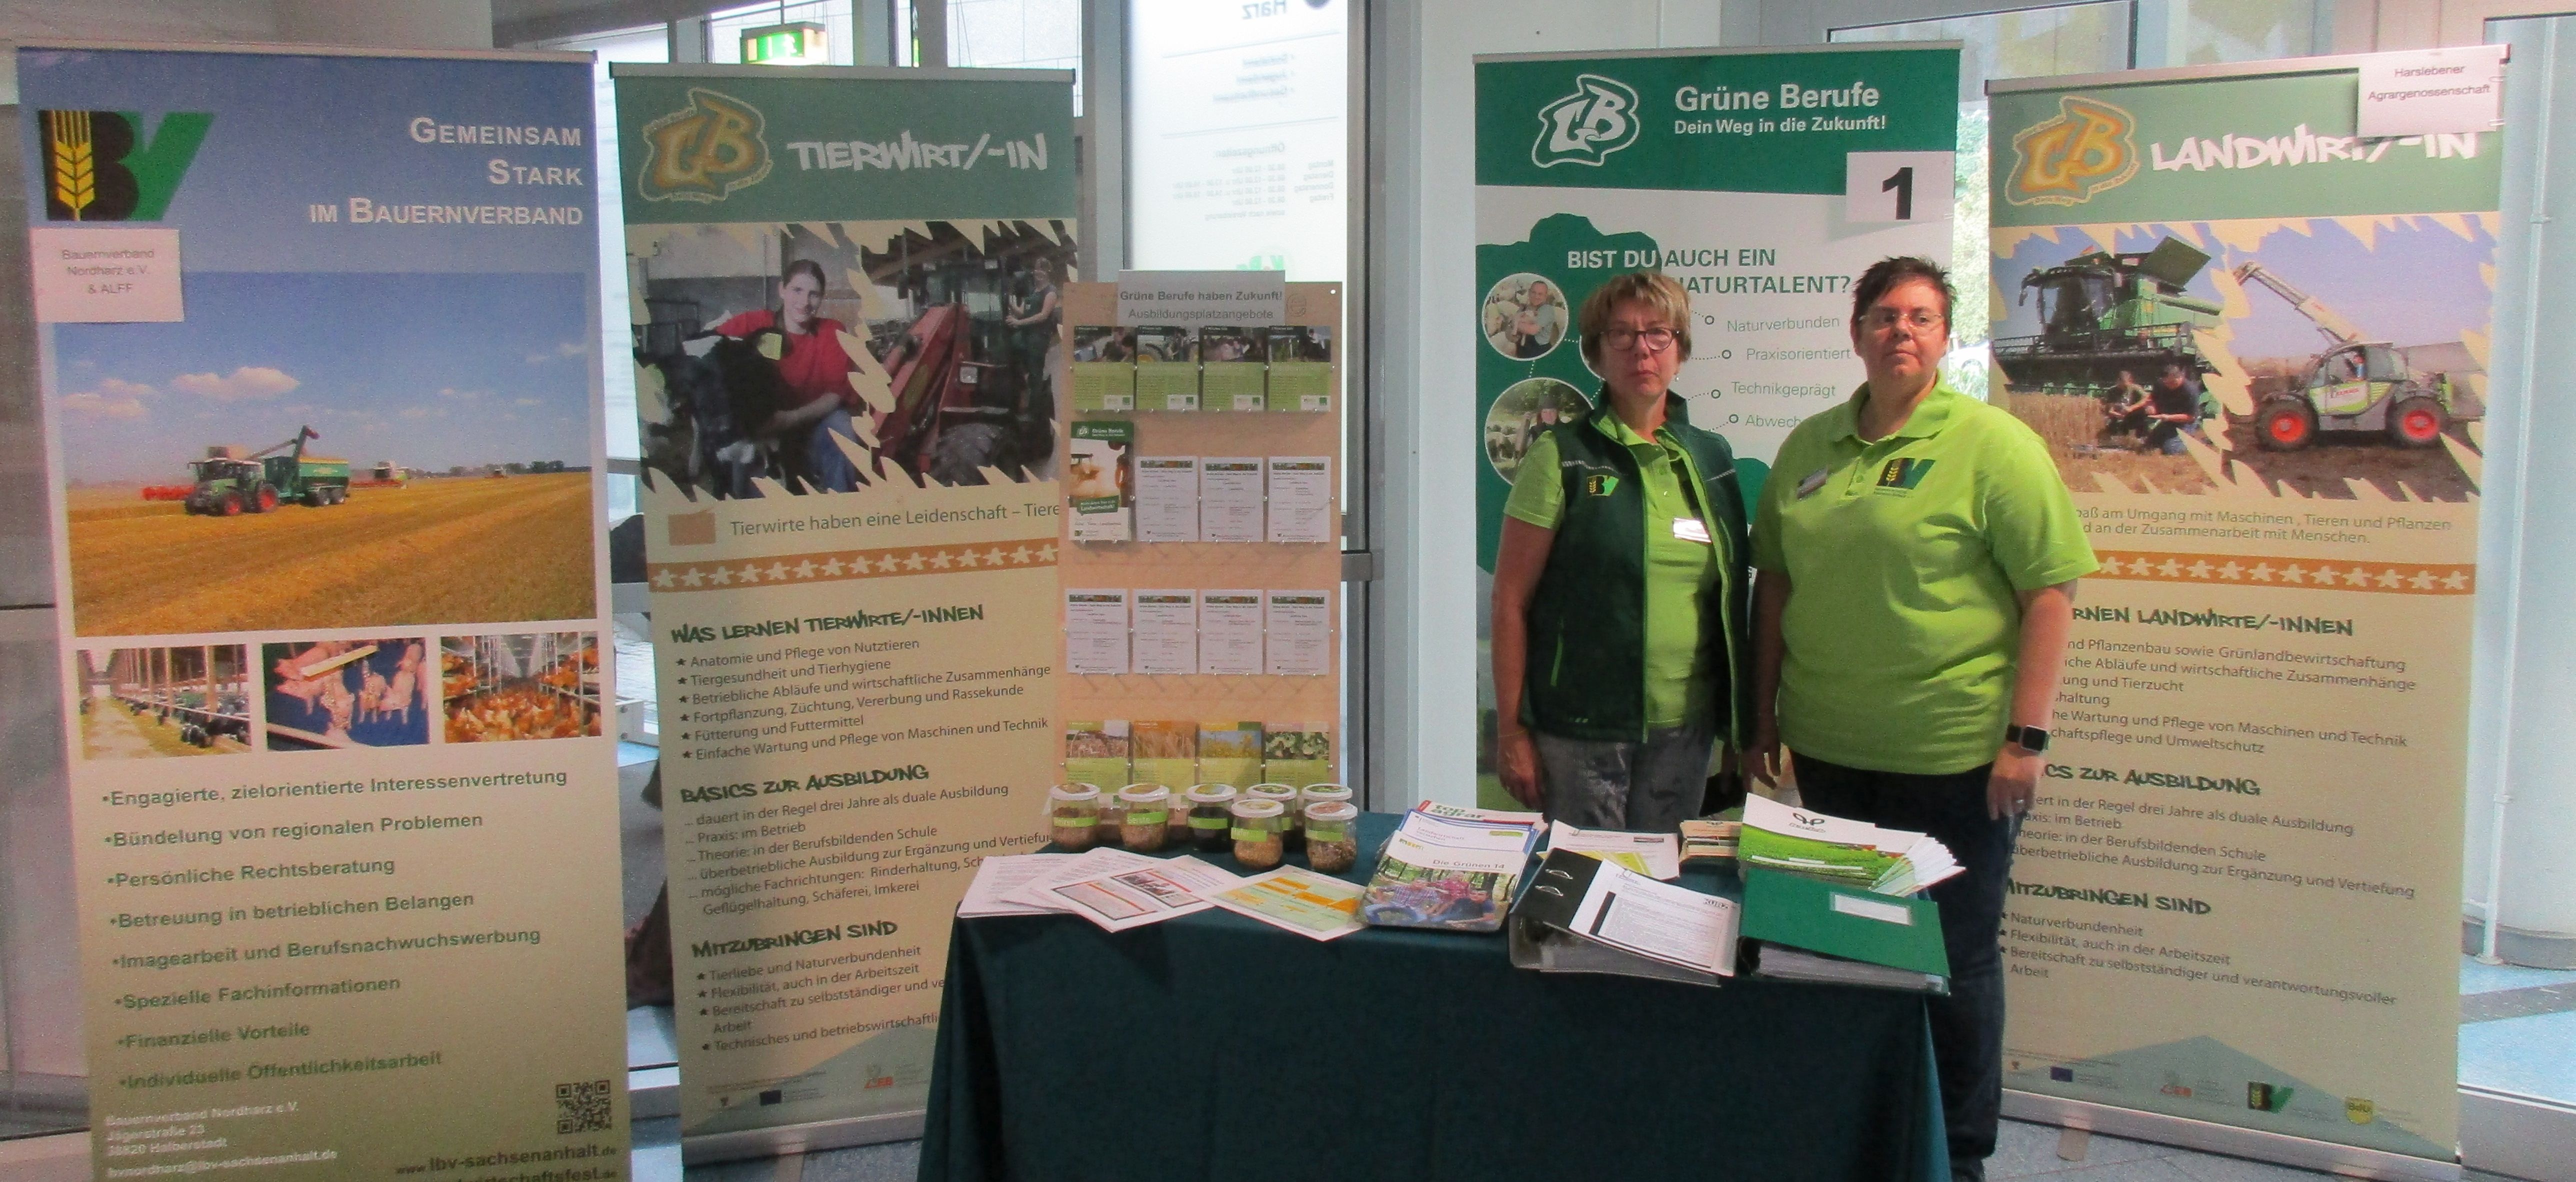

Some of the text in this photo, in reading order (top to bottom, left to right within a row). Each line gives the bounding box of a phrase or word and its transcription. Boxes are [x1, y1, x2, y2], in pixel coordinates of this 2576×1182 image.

[2394, 64, 2465, 78] Harslebener
[1675, 81, 1879, 112] Grüne Berufe
[2368, 84, 2490, 102] Agrargenossenschaft
[410, 116, 581, 147] GEMEINSAM
[1674, 115, 1886, 136] Dein Weg in die Zukunft!
[488, 160, 582, 186] STARK
[1882, 166, 1912, 219] 1
[310, 198, 582, 226] IM BAUERNVERBAND
[62, 250, 154, 260] Bauernverband
[1568, 248, 1776, 268] BIST DU AUCH EIN
[66, 266, 124, 275] Nordharz
[102, 283, 133, 294] ALFF
[1120, 290, 1282, 300] Grüne Berufe haben Zukunft!
[1128, 308, 1274, 322] Ausbildungsplatzangebote
[1727, 316, 1840, 332] Naturverbunden
[1747, 348, 1850, 360] Praxisorientiert
[1732, 382, 1836, 398] Technikgeprägt
[730, 502, 1060, 536] Tierwirte haben eine Leidenschaft Tiere
[2102, 510, 2124, 519] am
[2127, 508, 2186, 524] Umgang
[2190, 512, 2213, 522] mit
[2217, 510, 2294, 524] Maschinen
[2304, 513, 2349, 527] Tieren
[2353, 516, 2383, 528] und
[2386, 516, 2452, 530] Pflanzen
[2094, 522, 2370, 544] an der Zusammenarbeit mit Menschen.
[671, 624, 716, 643] WAS
[722, 618, 800, 640] LERNEN
[690, 640, 920, 666] Anatomie und Pflege von Nutztieren
[690, 660, 891, 688] Tiergesundheit und Tierhygiene
[692, 666, 1051, 705] Betriebliche Abläufe und wirtschaftliche Zusammenhänge
[2095, 658, 2416, 693] Abläufe und wirtschaftliche Zusammenhänge
[694, 684, 1024, 724] Fortpflanzung, Züchtung, Vererbung und Rassekunde
[694, 728, 758, 742] Fütterung
[762, 722, 787, 736] und
[696, 718, 1048, 760] Einfache Wartung und Pflege von Maschinen und Technik
[2070, 710, 2407, 747] Wartung und Pflege von Maschinen und Technik
[111, 772, 567, 809] Engagierte, zielorientierte Interessenvertretung
[680, 764, 929, 802] BASICS ZUR AUSBILDUNG
[696, 786, 1009, 826] dauert in der Regel drei Jahre als duale Ausbildung
[114, 815, 482, 847] Bündelung von regionalen Problemen
[116, 860, 395, 887] Persönliche Rechtsberatung
[118, 894, 474, 928] Betreuung in betrieblichen Belangen
[120, 930, 540, 971] Imagearbeit und Berufsnachwuchswerbung
[692, 920, 898, 957] MITZUBRINGEN SIND
[120, 979, 400, 1011] Spezielle Fachinformationen
[122, 1022, 310, 1048] Finanzielle Vorteile
[125, 1051, 442, 1089] Individuelle Öffentlichkeitsarbeit
